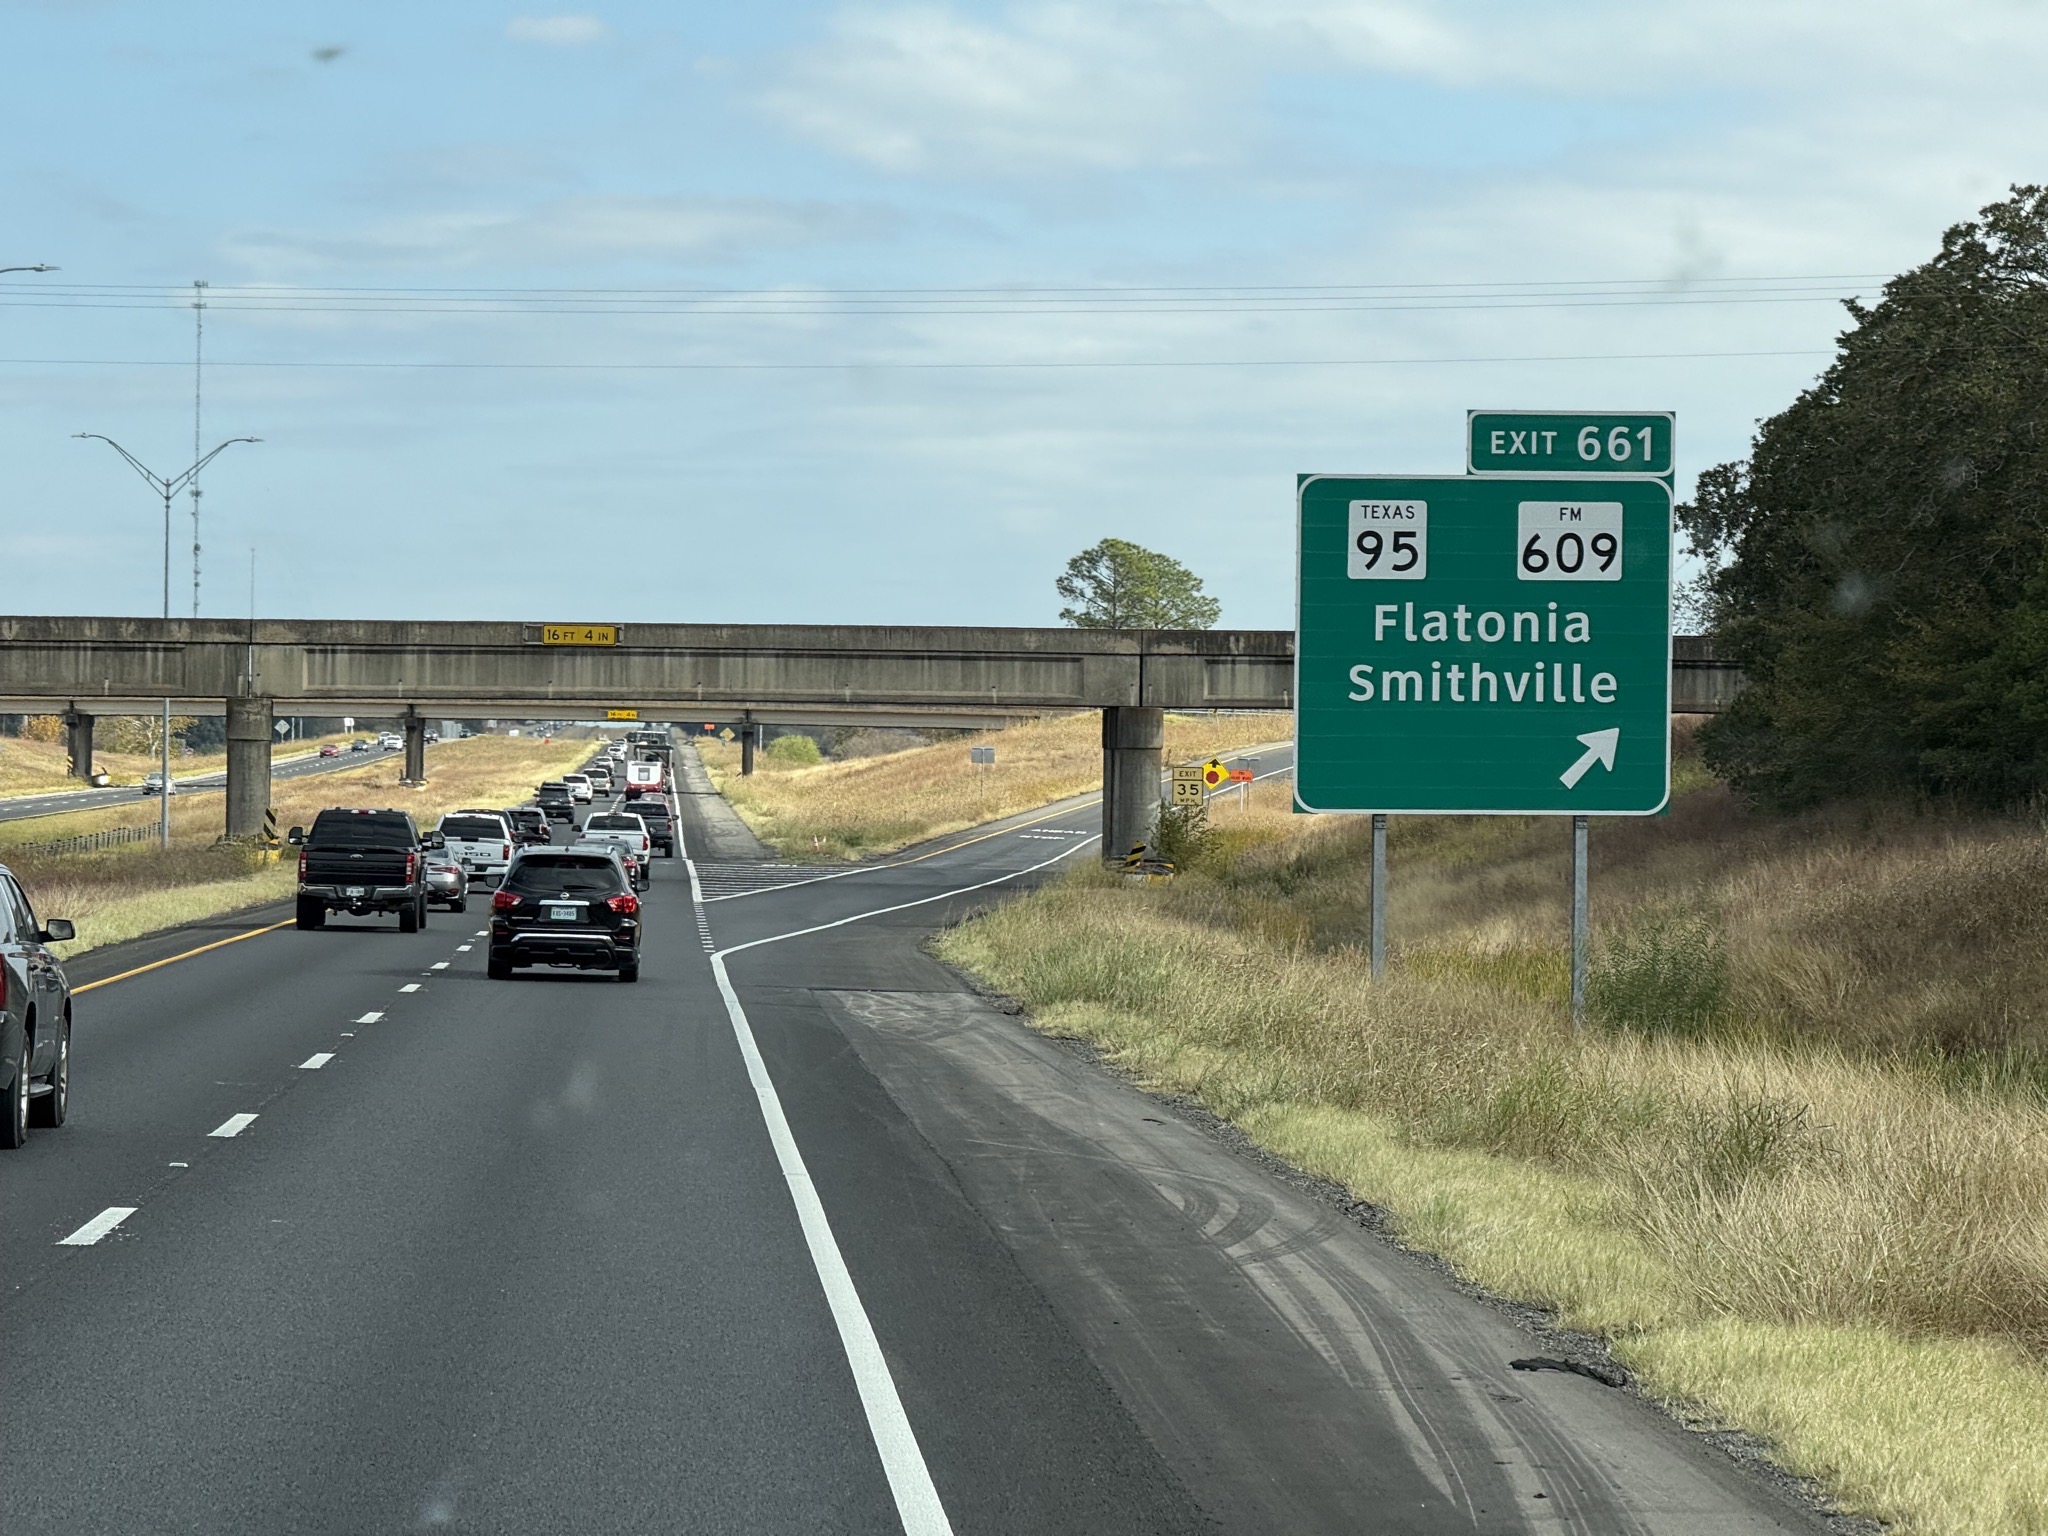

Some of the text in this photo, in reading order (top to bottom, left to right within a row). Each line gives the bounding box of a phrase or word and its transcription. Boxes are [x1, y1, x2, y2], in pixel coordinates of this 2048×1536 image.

[1490, 426, 1652, 462] EXIT 661
[1361, 504, 1415, 520] TEXAS
[1559, 507, 1582, 522] FM
[1356, 530, 1418, 572] 95
[1522, 532, 1618, 574] 609
[547, 628, 609, 642] 16 FT 4 IN
[1374, 601, 1591, 644] Flatonia
[1348, 661, 1618, 703] Smithville
[1177, 783, 1199, 796] 35
